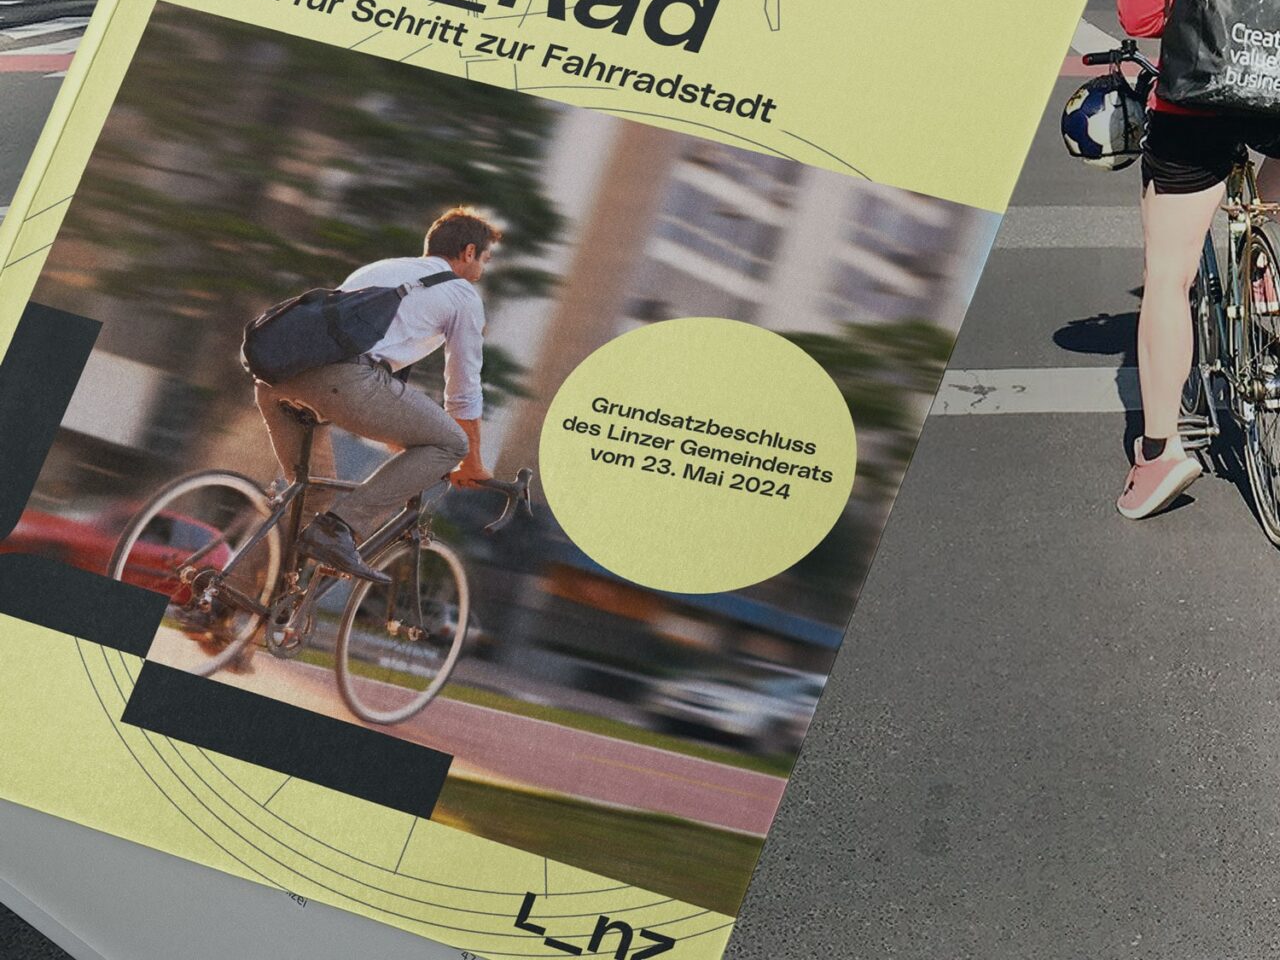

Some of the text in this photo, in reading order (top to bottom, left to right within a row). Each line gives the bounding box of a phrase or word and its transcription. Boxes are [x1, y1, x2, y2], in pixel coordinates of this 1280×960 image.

[475, 33, 535, 61] zur
[541, 43, 777, 124] Fahrradstadt
[1230, 47, 1277, 68] value
[562, 415, 833, 483] des Linzer Gemeinderats
[591, 397, 817, 455] Grundsatzbeschluss
[590, 447, 791, 500] vom 23. Mai 2024
